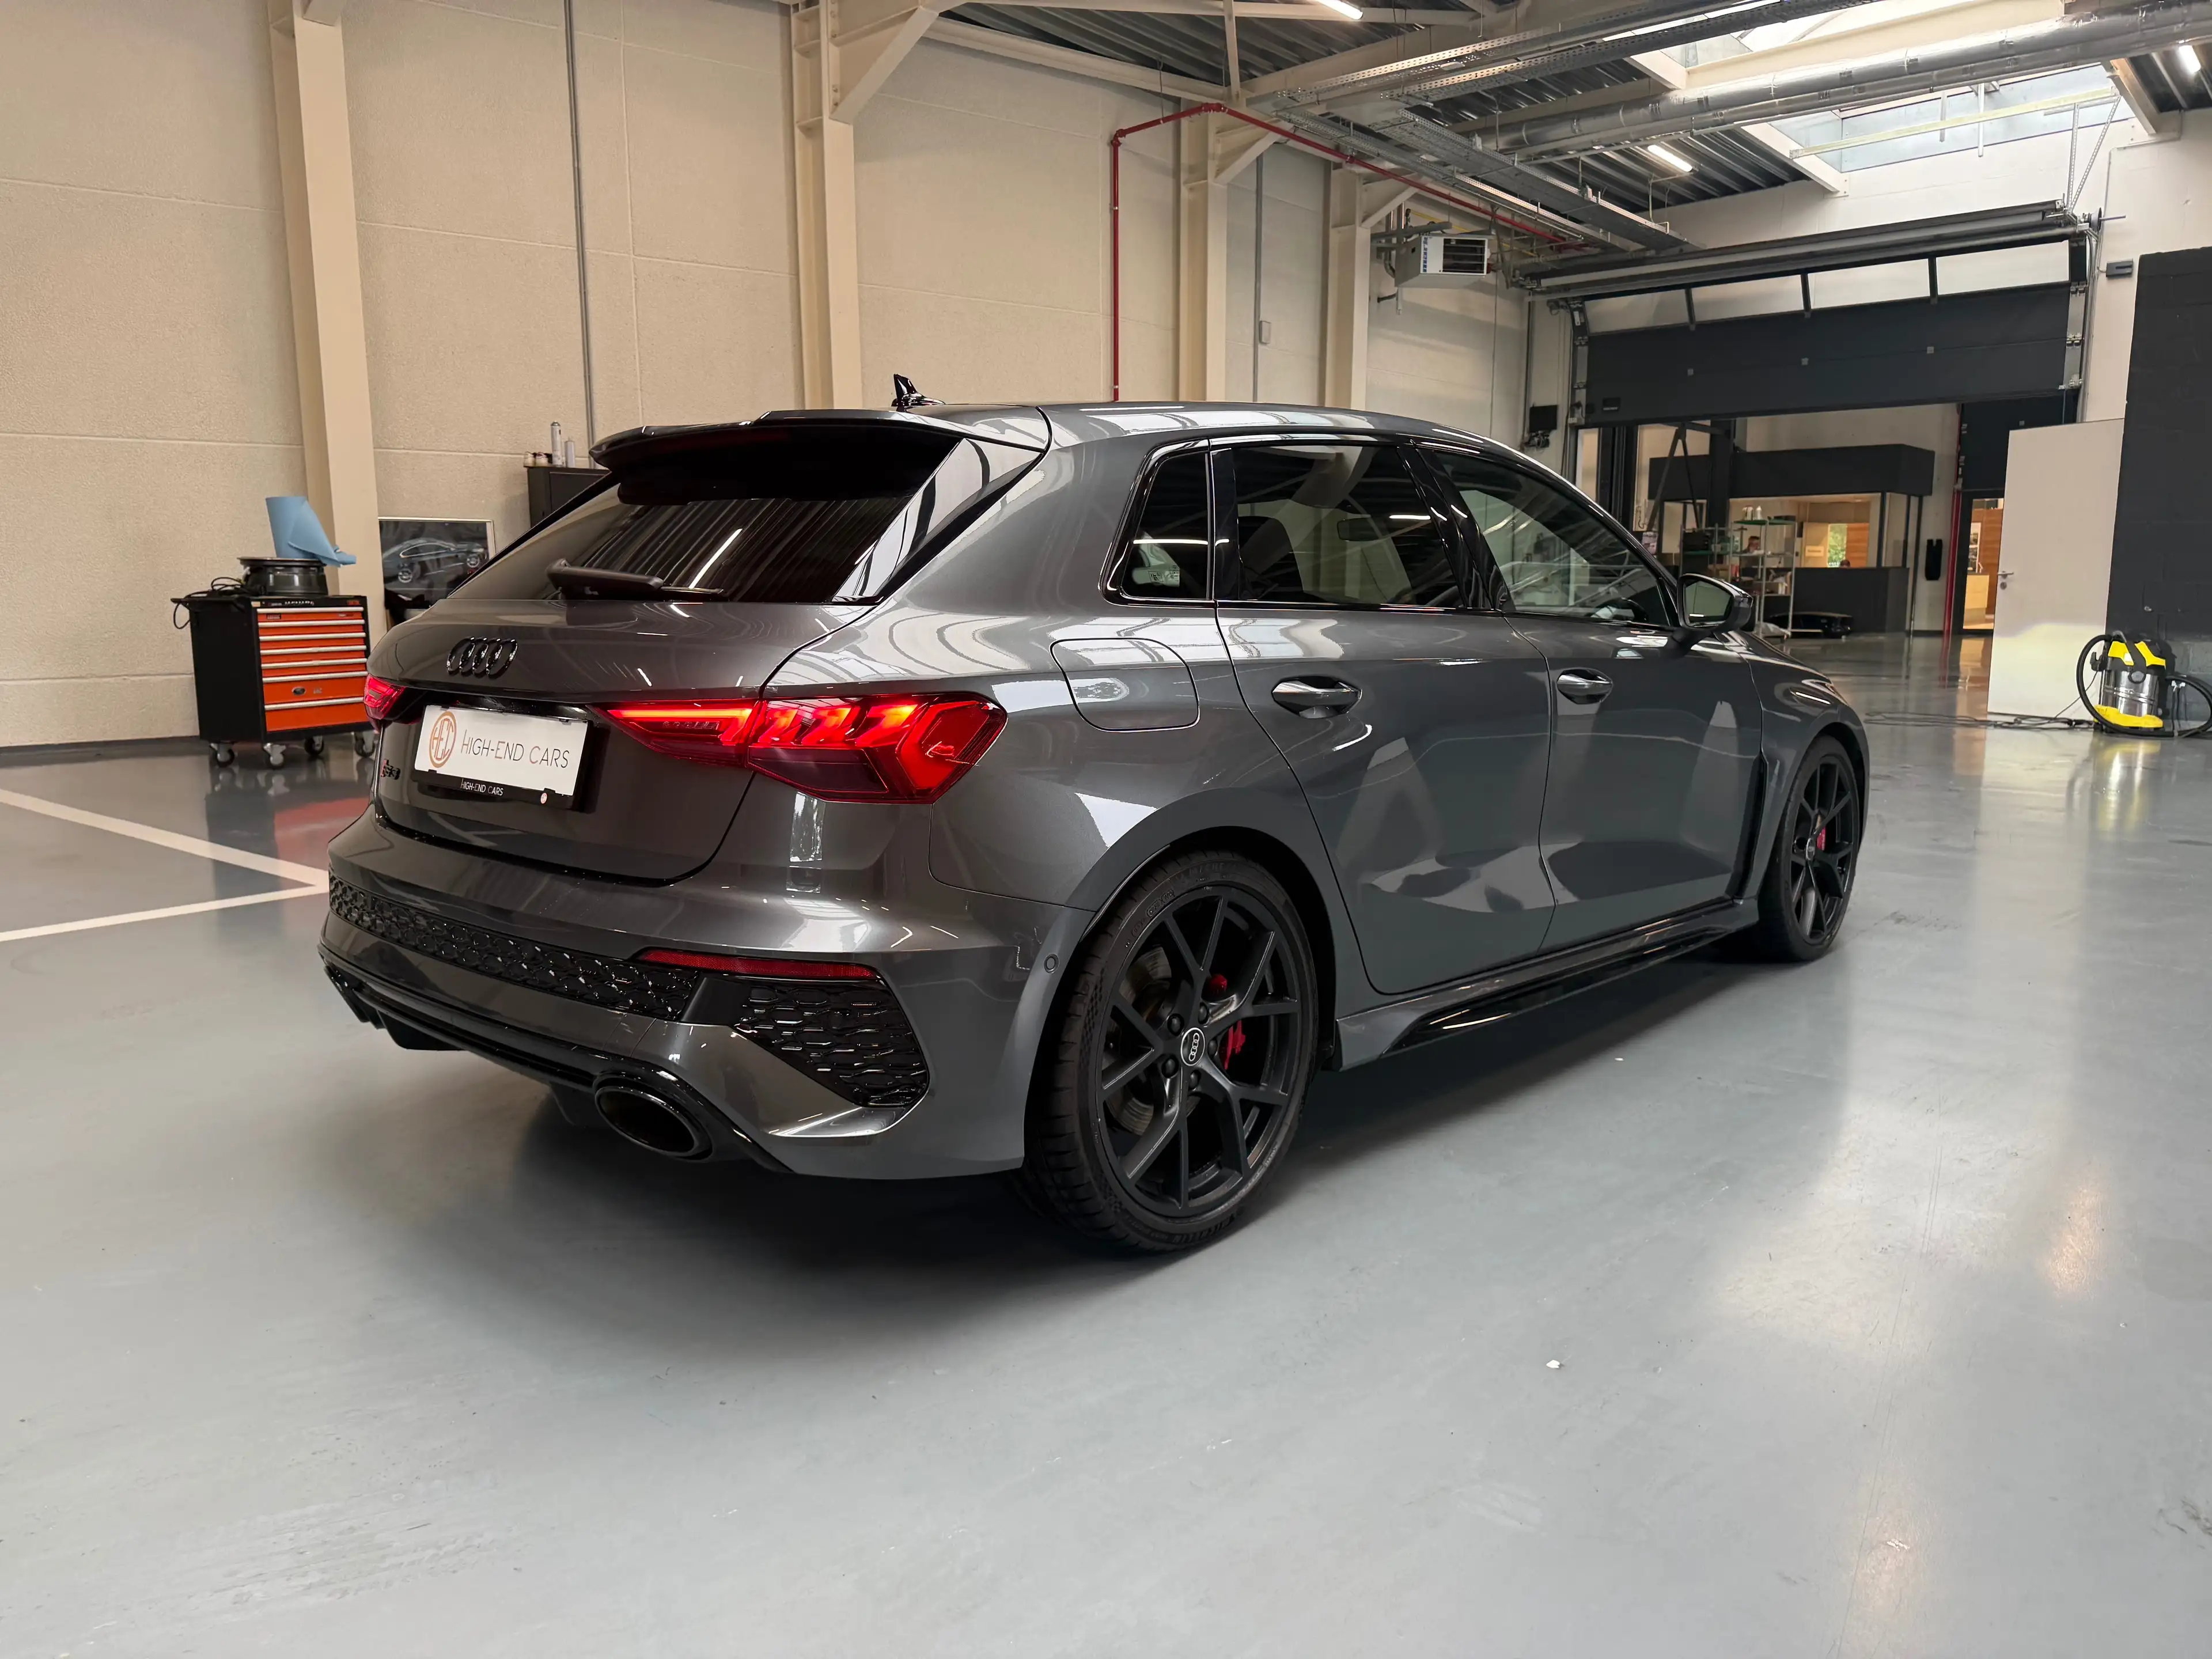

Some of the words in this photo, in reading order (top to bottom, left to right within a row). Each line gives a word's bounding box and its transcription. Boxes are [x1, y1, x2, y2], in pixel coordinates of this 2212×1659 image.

[461, 729, 524, 762] HIGH-END
[529, 745, 570, 768] CARS
[460, 778, 486, 793] HIGH-END
[488, 786, 504, 796] CARS
